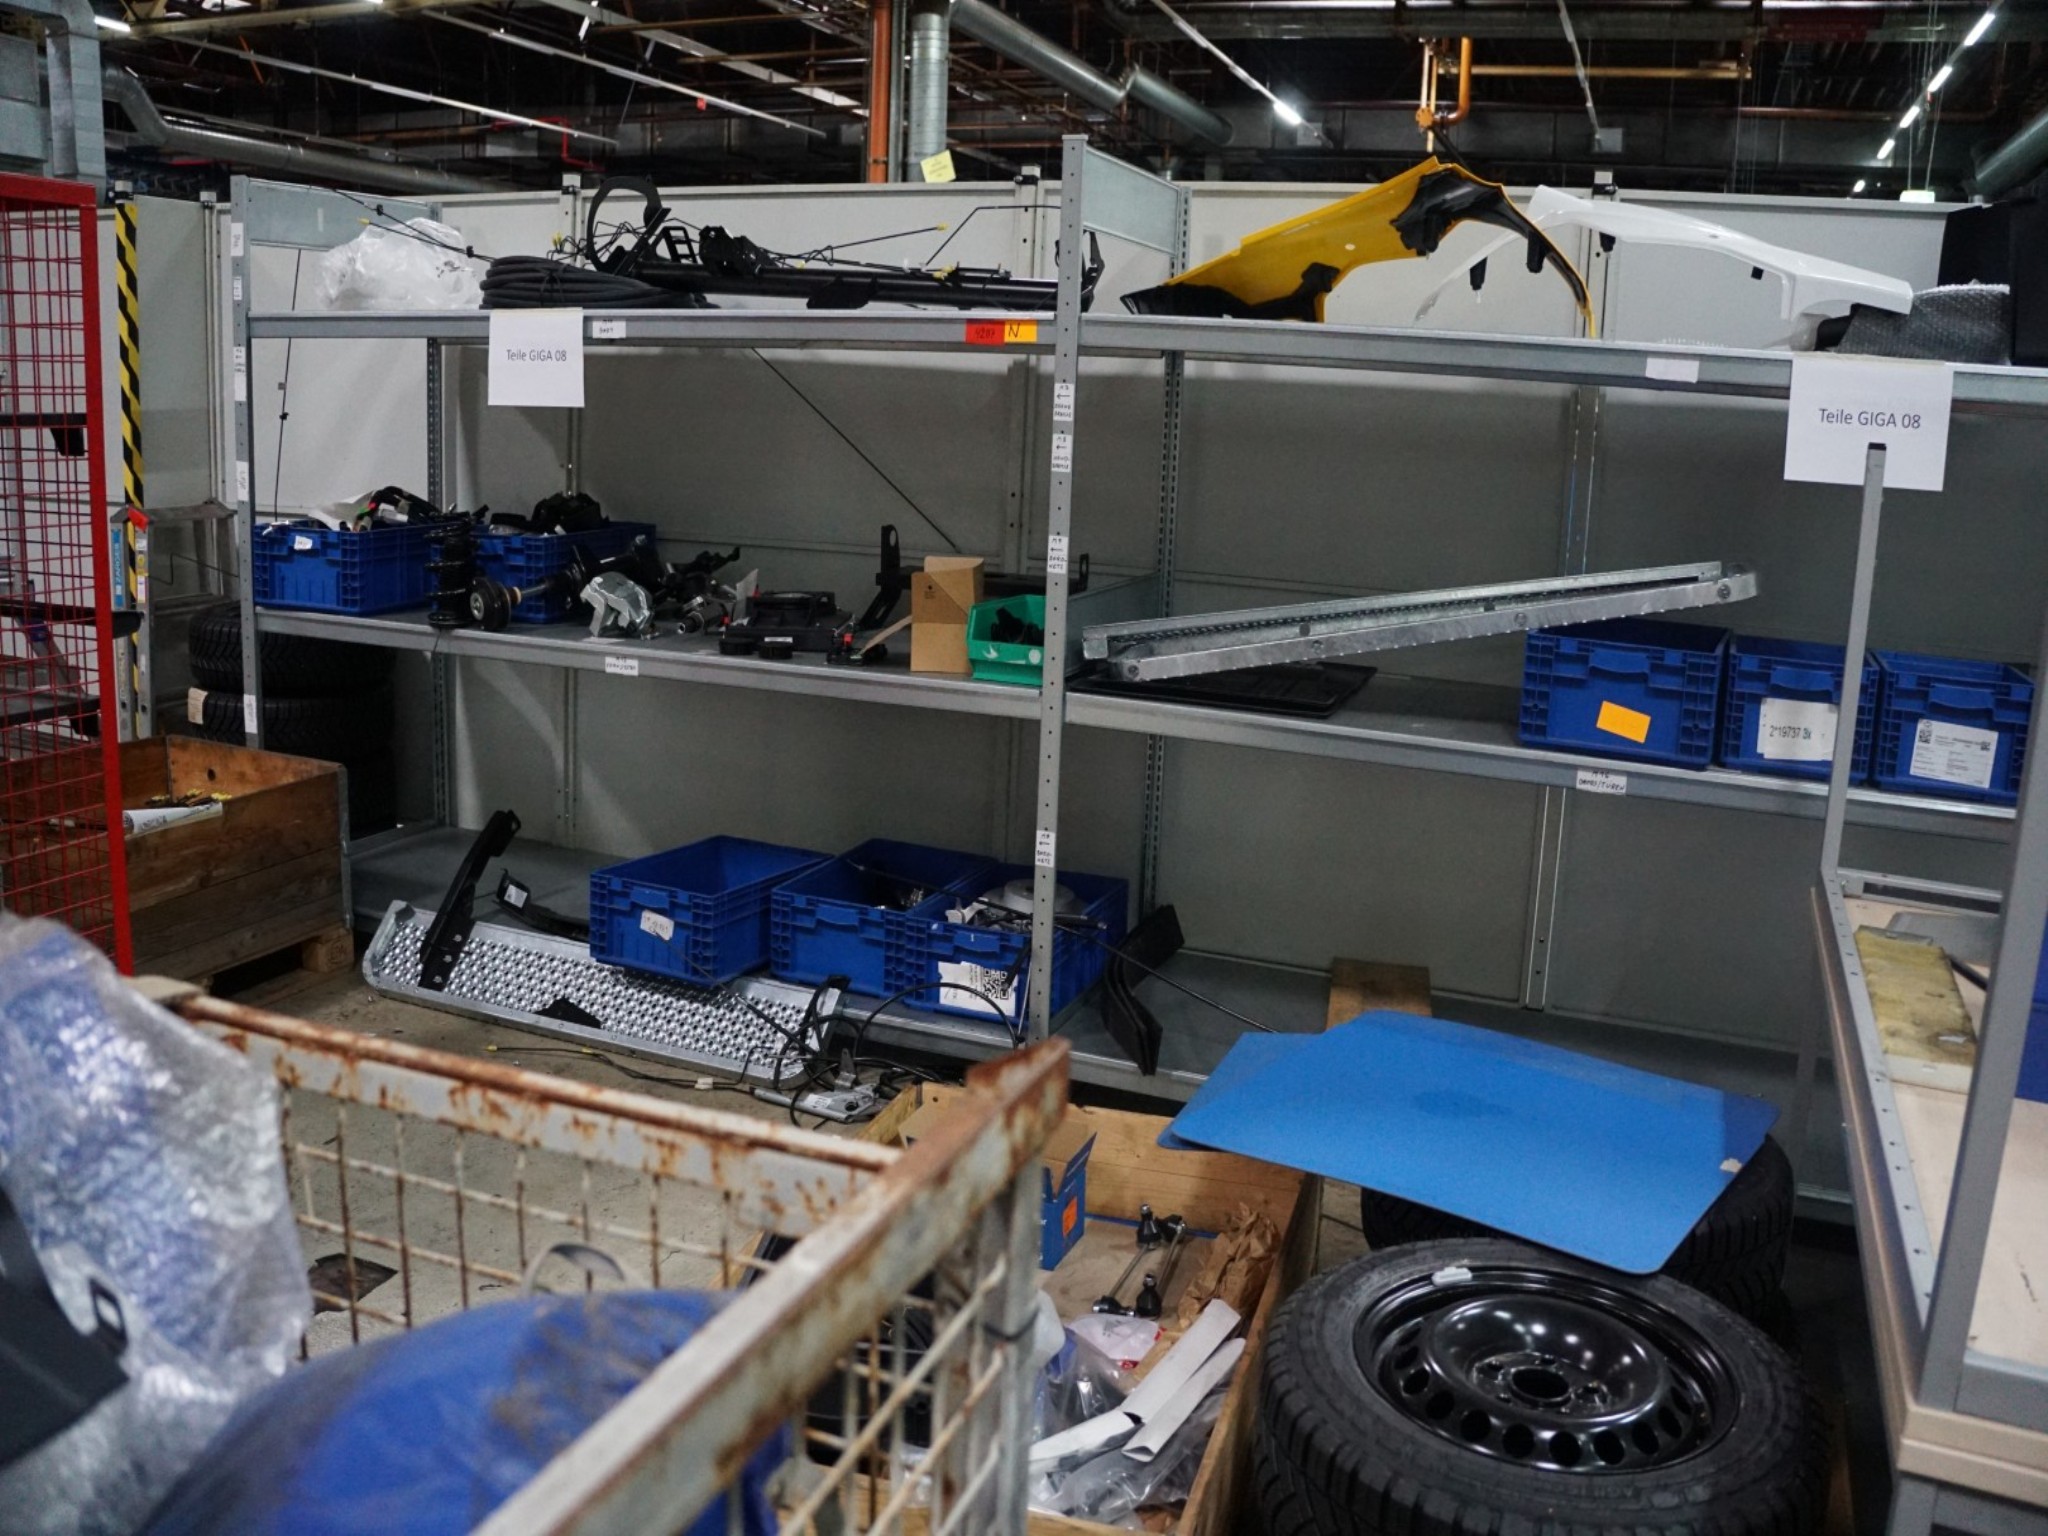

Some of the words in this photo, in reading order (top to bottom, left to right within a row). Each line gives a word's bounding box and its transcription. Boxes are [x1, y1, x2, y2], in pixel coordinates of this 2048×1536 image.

[506, 349, 527, 361] Teile
[529, 350, 553, 362] GIGA
[555, 350, 567, 362] 08
[1818, 408, 1853, 425] Teile
[1857, 411, 1897, 428] GIGA
[1901, 413, 1921, 430] 08
